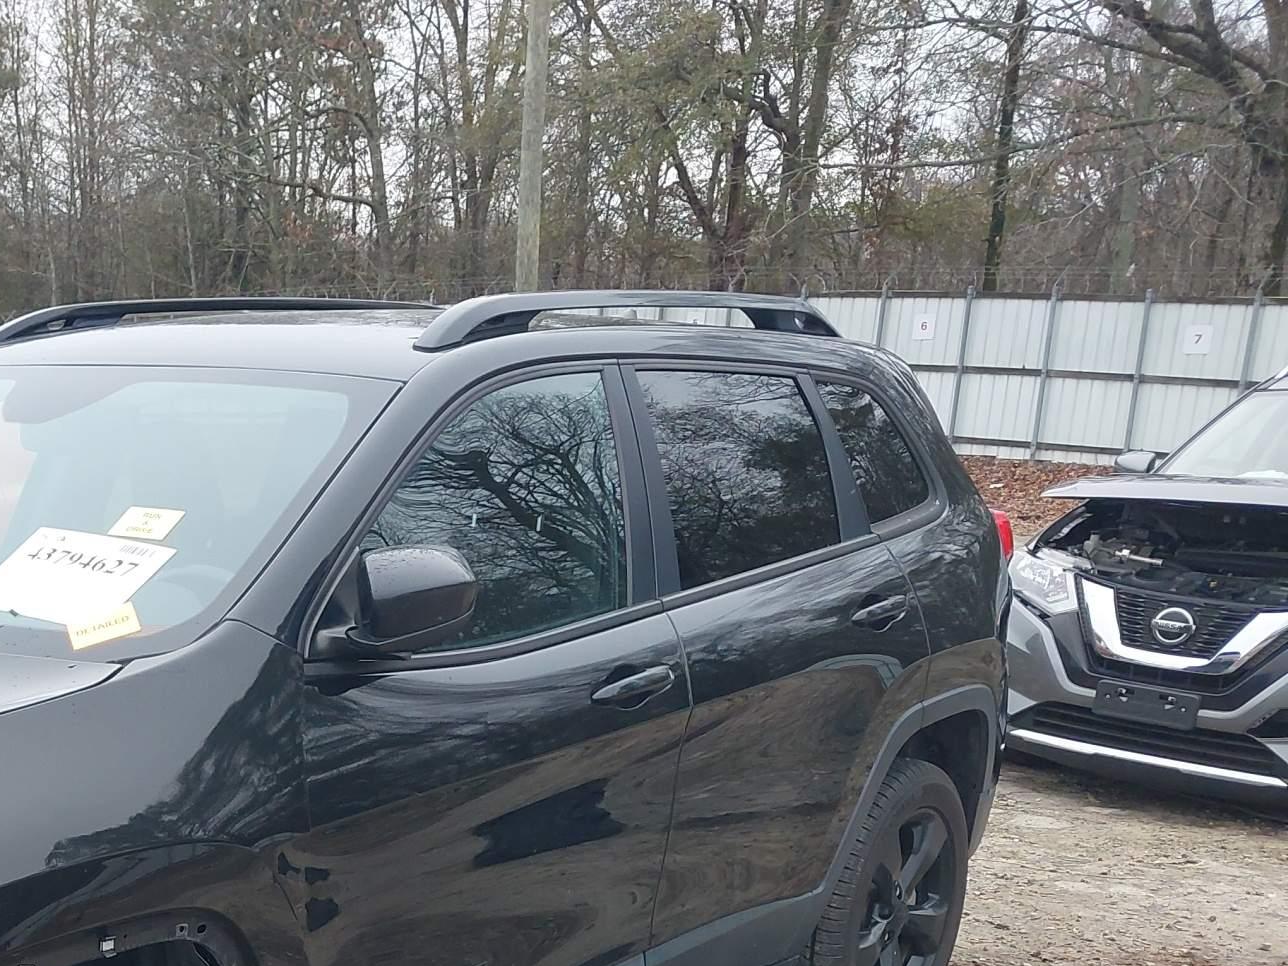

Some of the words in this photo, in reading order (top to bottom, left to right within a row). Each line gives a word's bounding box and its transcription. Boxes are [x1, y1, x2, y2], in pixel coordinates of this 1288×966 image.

[920, 321, 928, 331] 6
[1193, 334, 1203, 345] 7
[26, 546, 141, 577] 43794627
[74, 614, 130, 638] DETAILED
